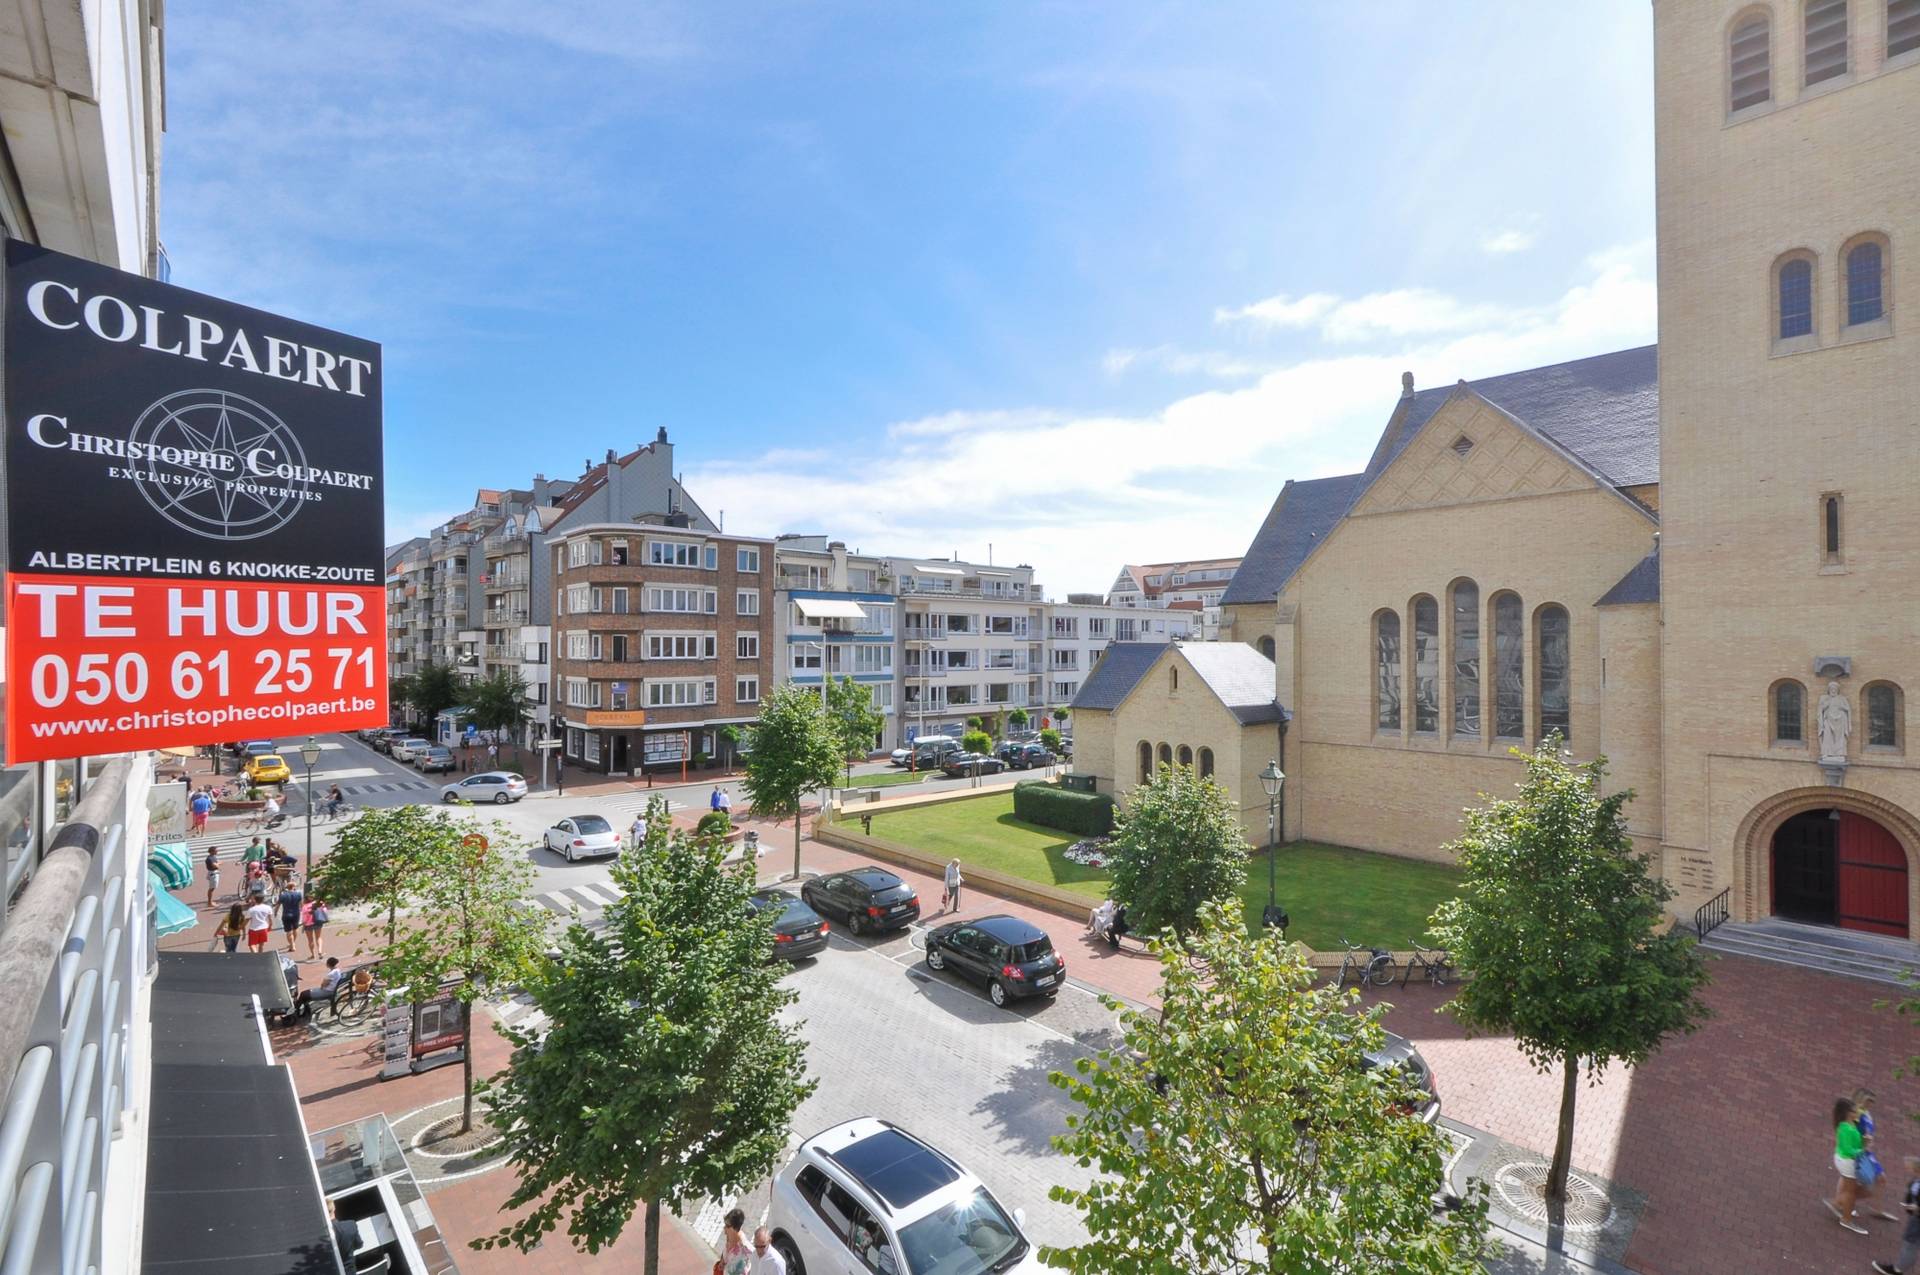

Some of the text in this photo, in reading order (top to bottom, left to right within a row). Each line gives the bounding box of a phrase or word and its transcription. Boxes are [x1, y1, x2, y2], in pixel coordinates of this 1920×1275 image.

[26, 280, 372, 398] COLPAERT
[26, 413, 373, 491] CHRISTOPHE COLPAERT
[108, 467, 323, 501] EXCLUSIVE PROPERTIES
[28, 551, 375, 582] ALBERTPLEIN 6 KNOKKE-ZOUTE
[17, 585, 368, 638] TE HUUR
[31, 646, 375, 708] 050 61 25 71
[31, 696, 376, 738] www.christophecolpaert.be
